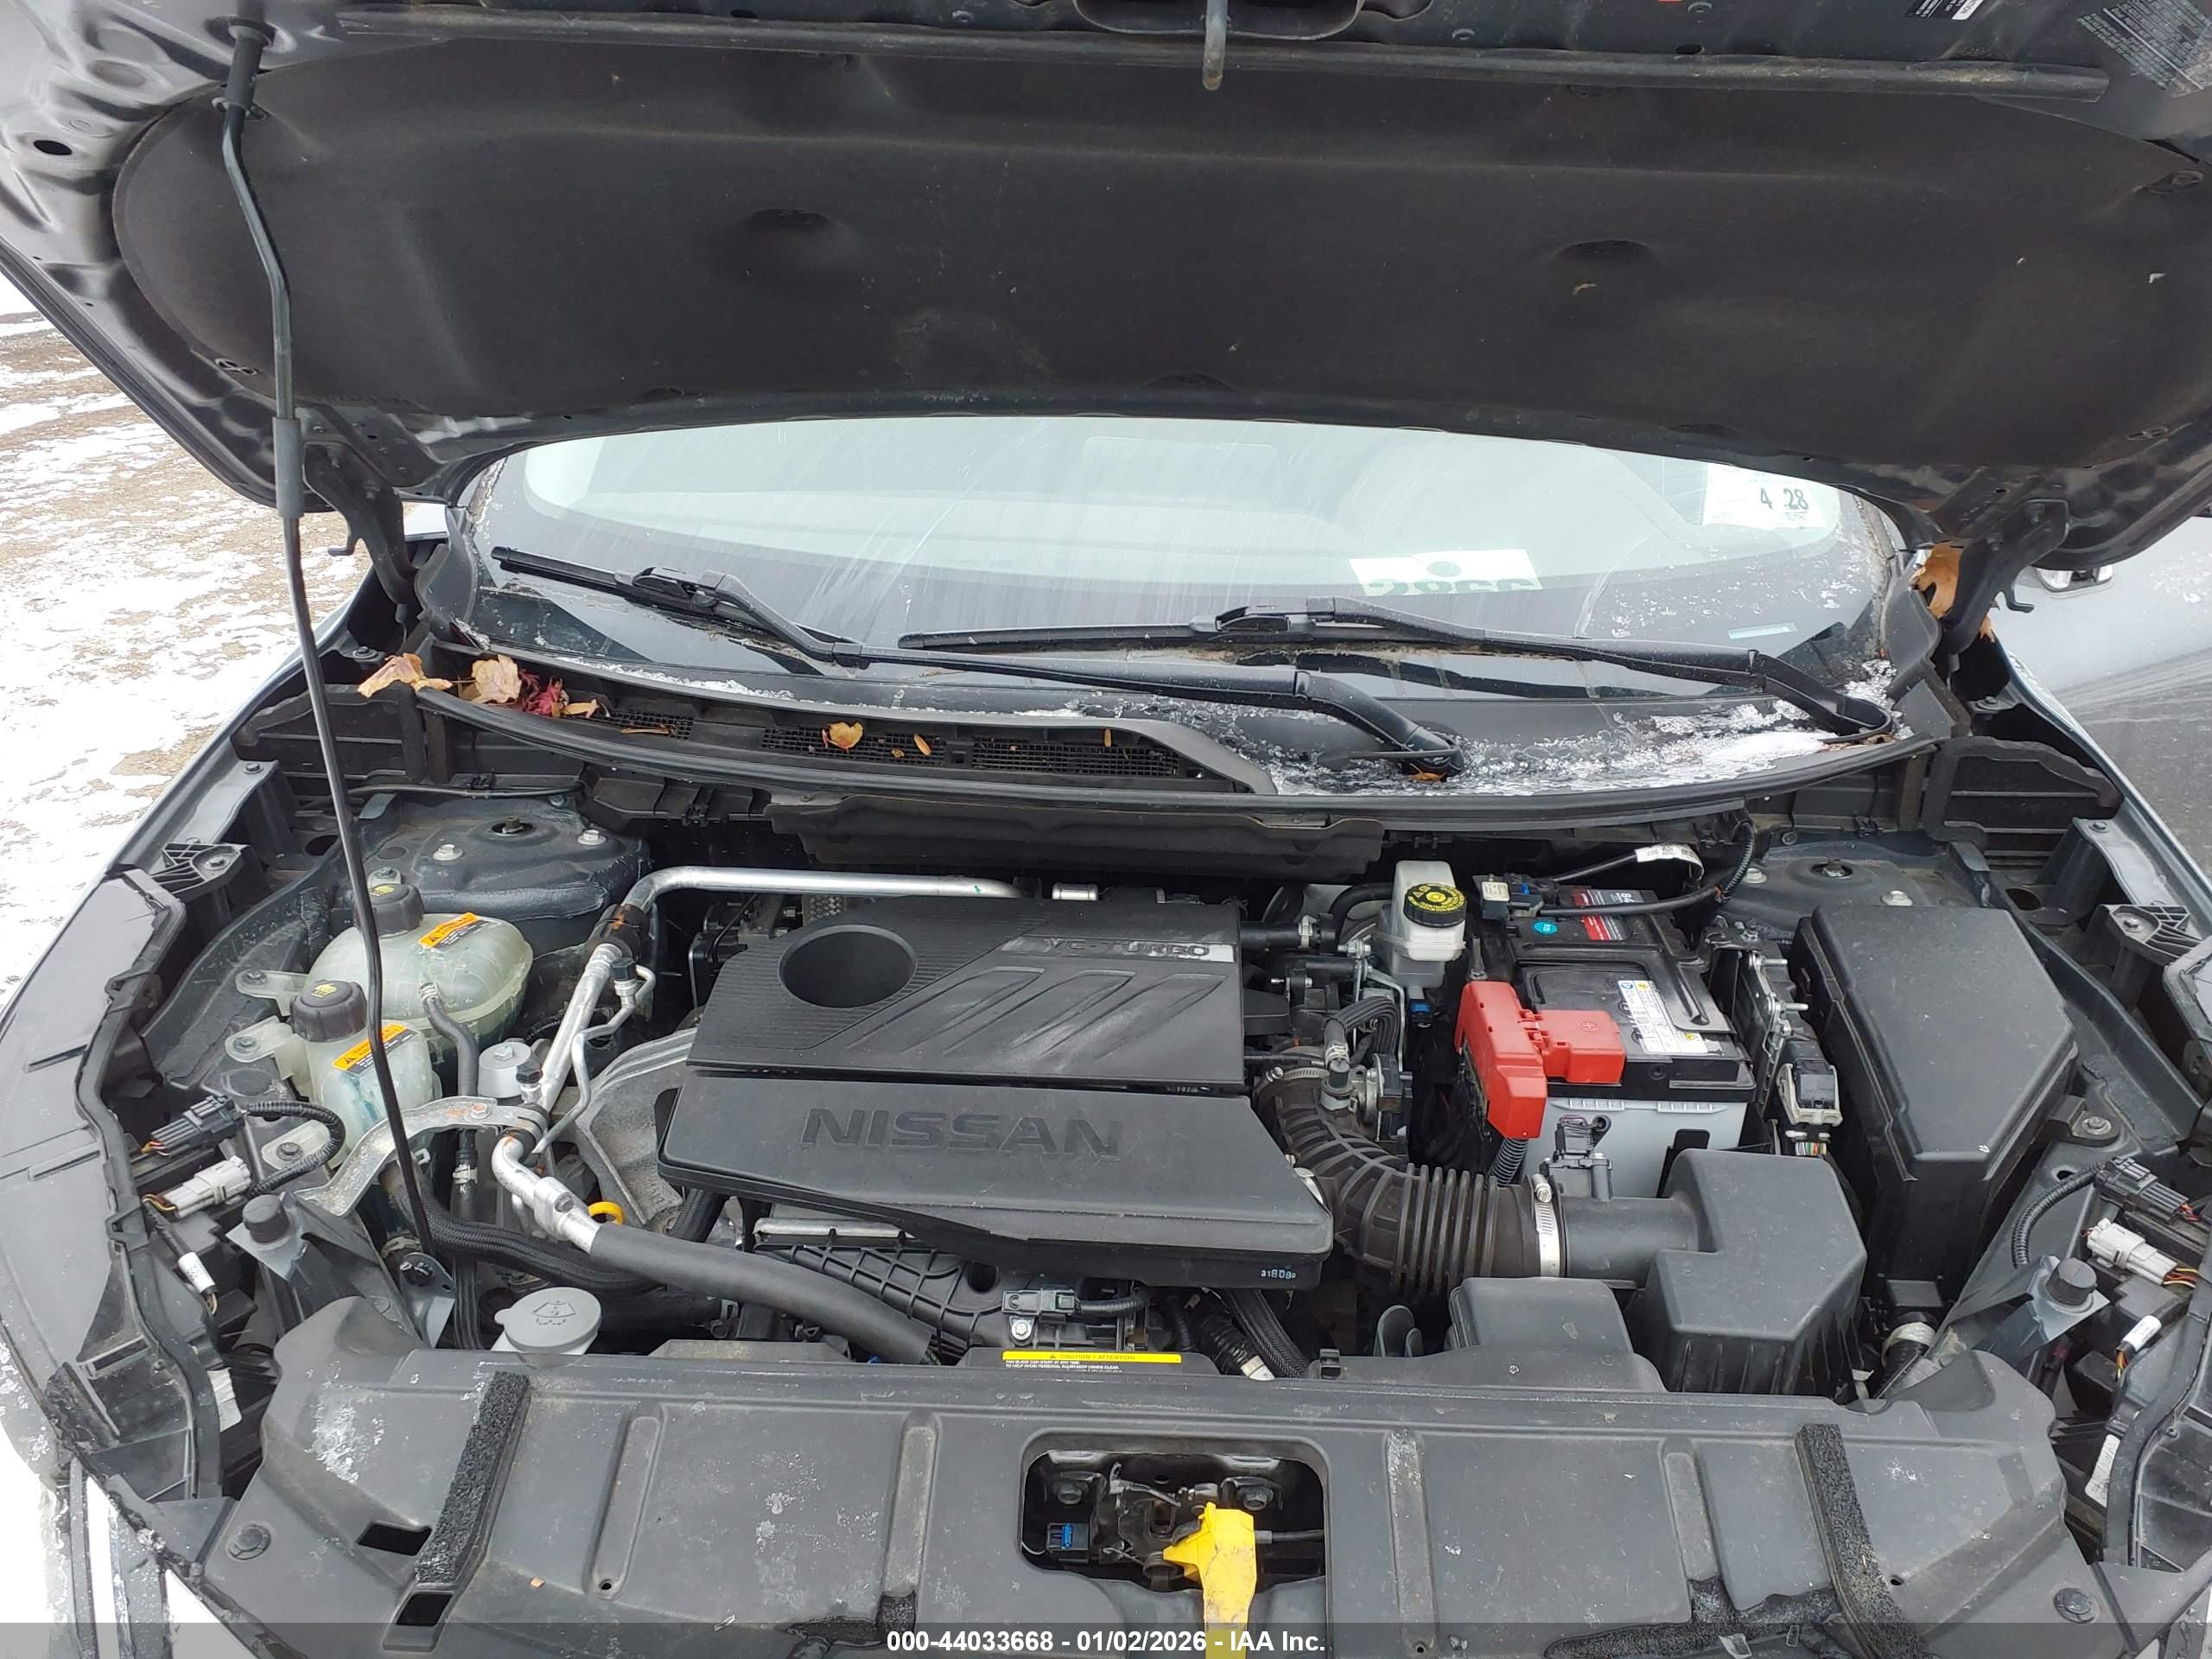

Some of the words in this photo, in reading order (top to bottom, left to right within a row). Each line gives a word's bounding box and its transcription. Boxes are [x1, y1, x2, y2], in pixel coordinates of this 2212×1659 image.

[1760, 487, 1773, 509] 4
[1783, 488, 1809, 510] 28
[800, 1108, 1121, 1161] NISSAN
